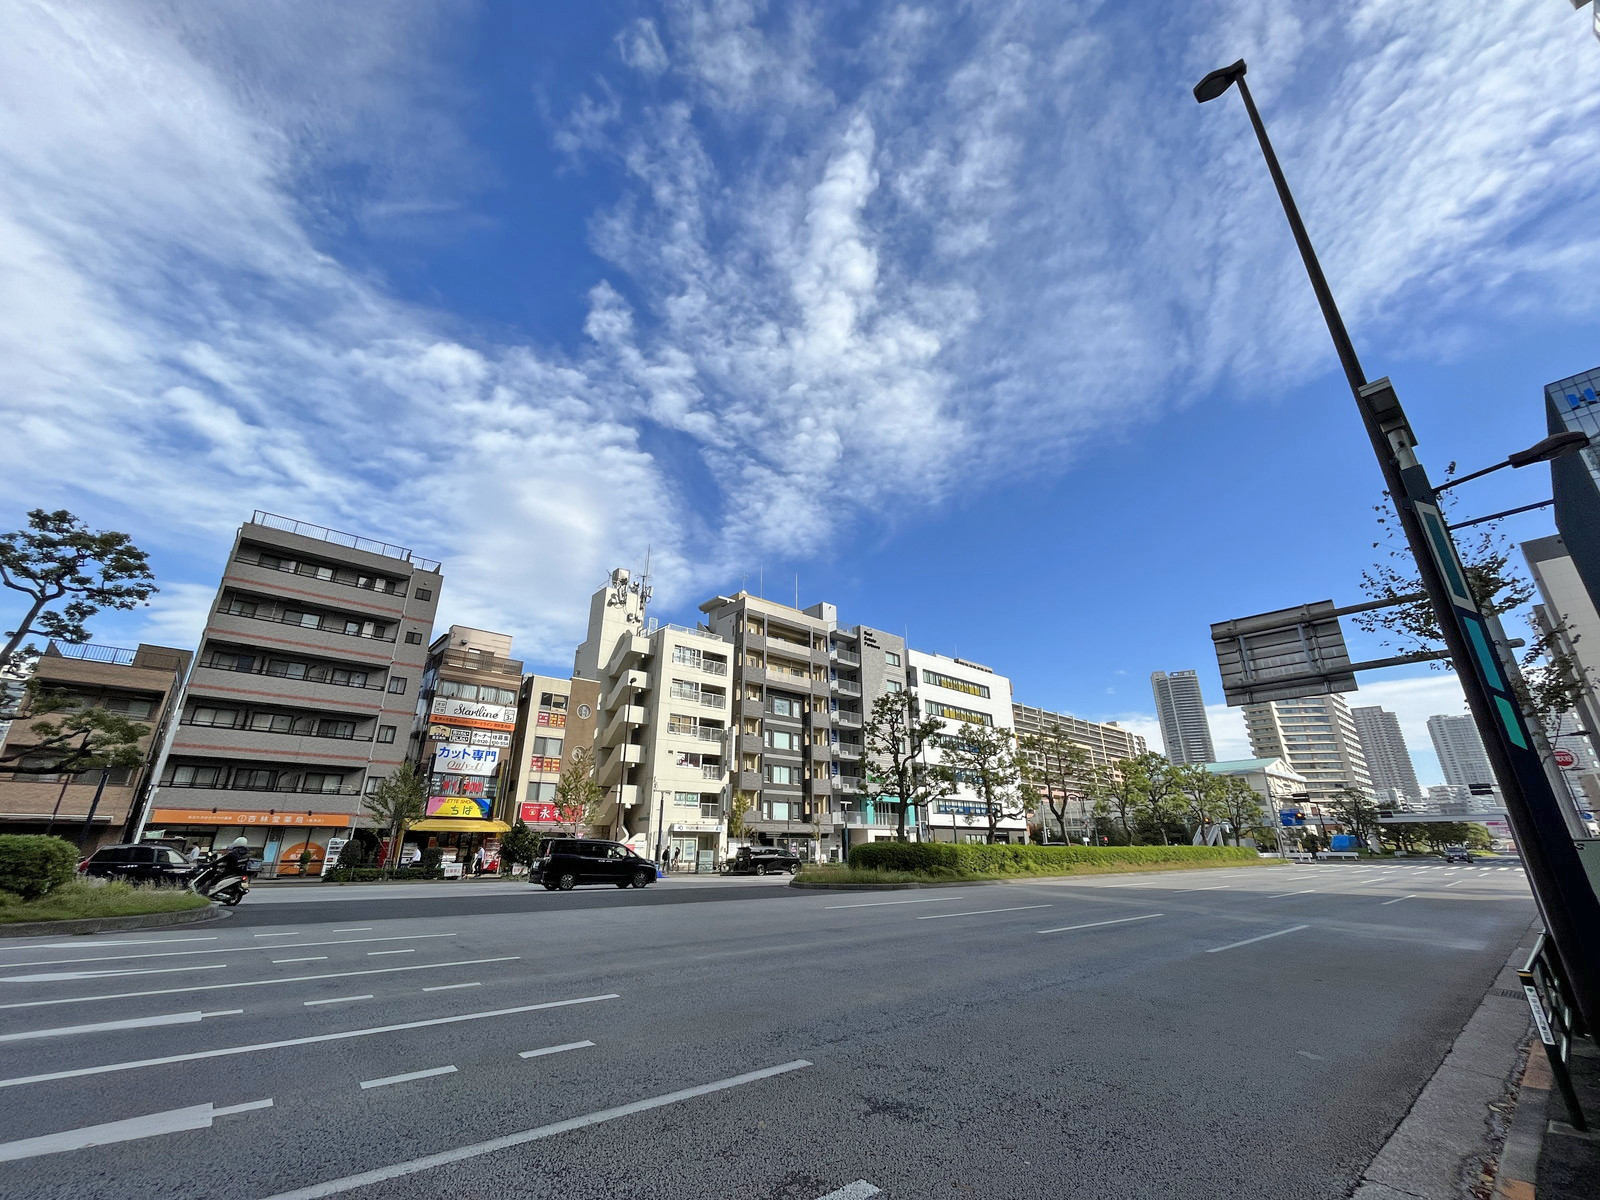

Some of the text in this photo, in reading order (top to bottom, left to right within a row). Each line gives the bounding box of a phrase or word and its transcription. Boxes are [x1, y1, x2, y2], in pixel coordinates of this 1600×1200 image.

[453, 703, 499, 719] Startline
[438, 747, 497, 762] カット専門
